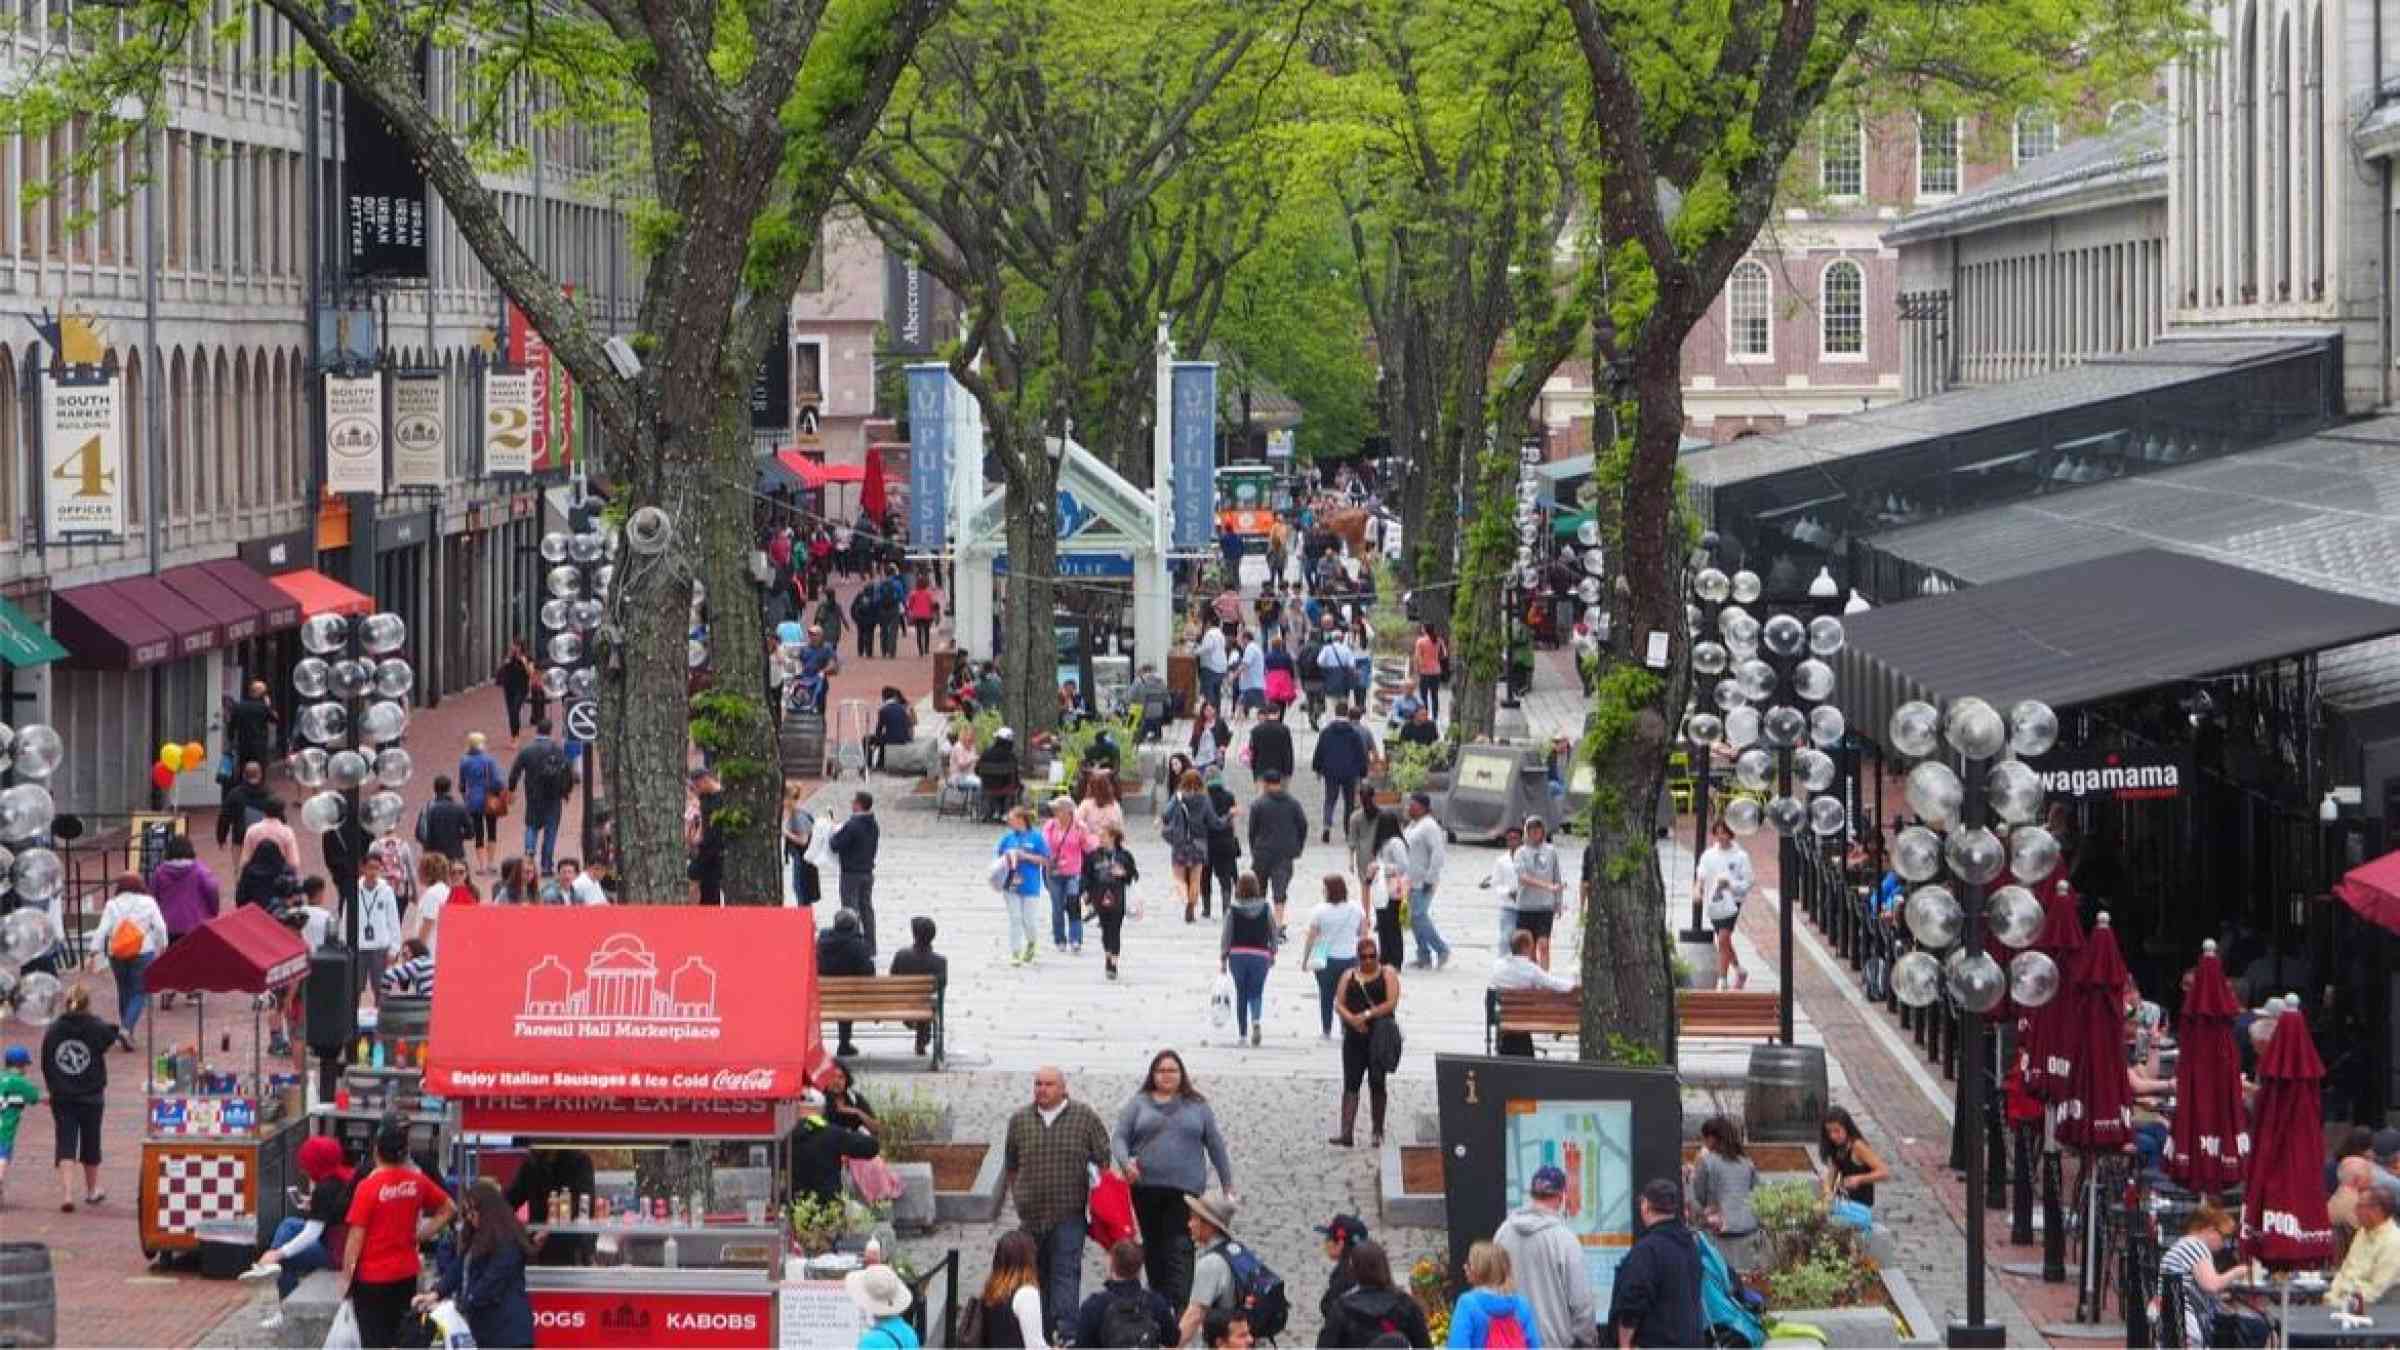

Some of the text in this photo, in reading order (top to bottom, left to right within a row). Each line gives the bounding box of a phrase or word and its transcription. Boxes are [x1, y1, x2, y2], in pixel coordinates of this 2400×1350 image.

[57, 395, 110, 406] SOUTH
[488, 408, 529, 449] 2
[52, 433, 115, 499] 4
[2034, 764, 2178, 796] wagamama
[514, 1023, 720, 1042] Faneuil Hall Marketplace
[452, 1070, 496, 1087] Enjoy
[500, 1071, 549, 1085] Italian
[552, 1072, 626, 1088] Sausages
[629, 1074, 641, 1087] &
[646, 1074, 668, 1087] Ice
[672, 1073, 708, 1088] Cold
[474, 1095, 767, 1113] THE PRIME EXPRESS
[665, 1313, 757, 1330] KABOBS
